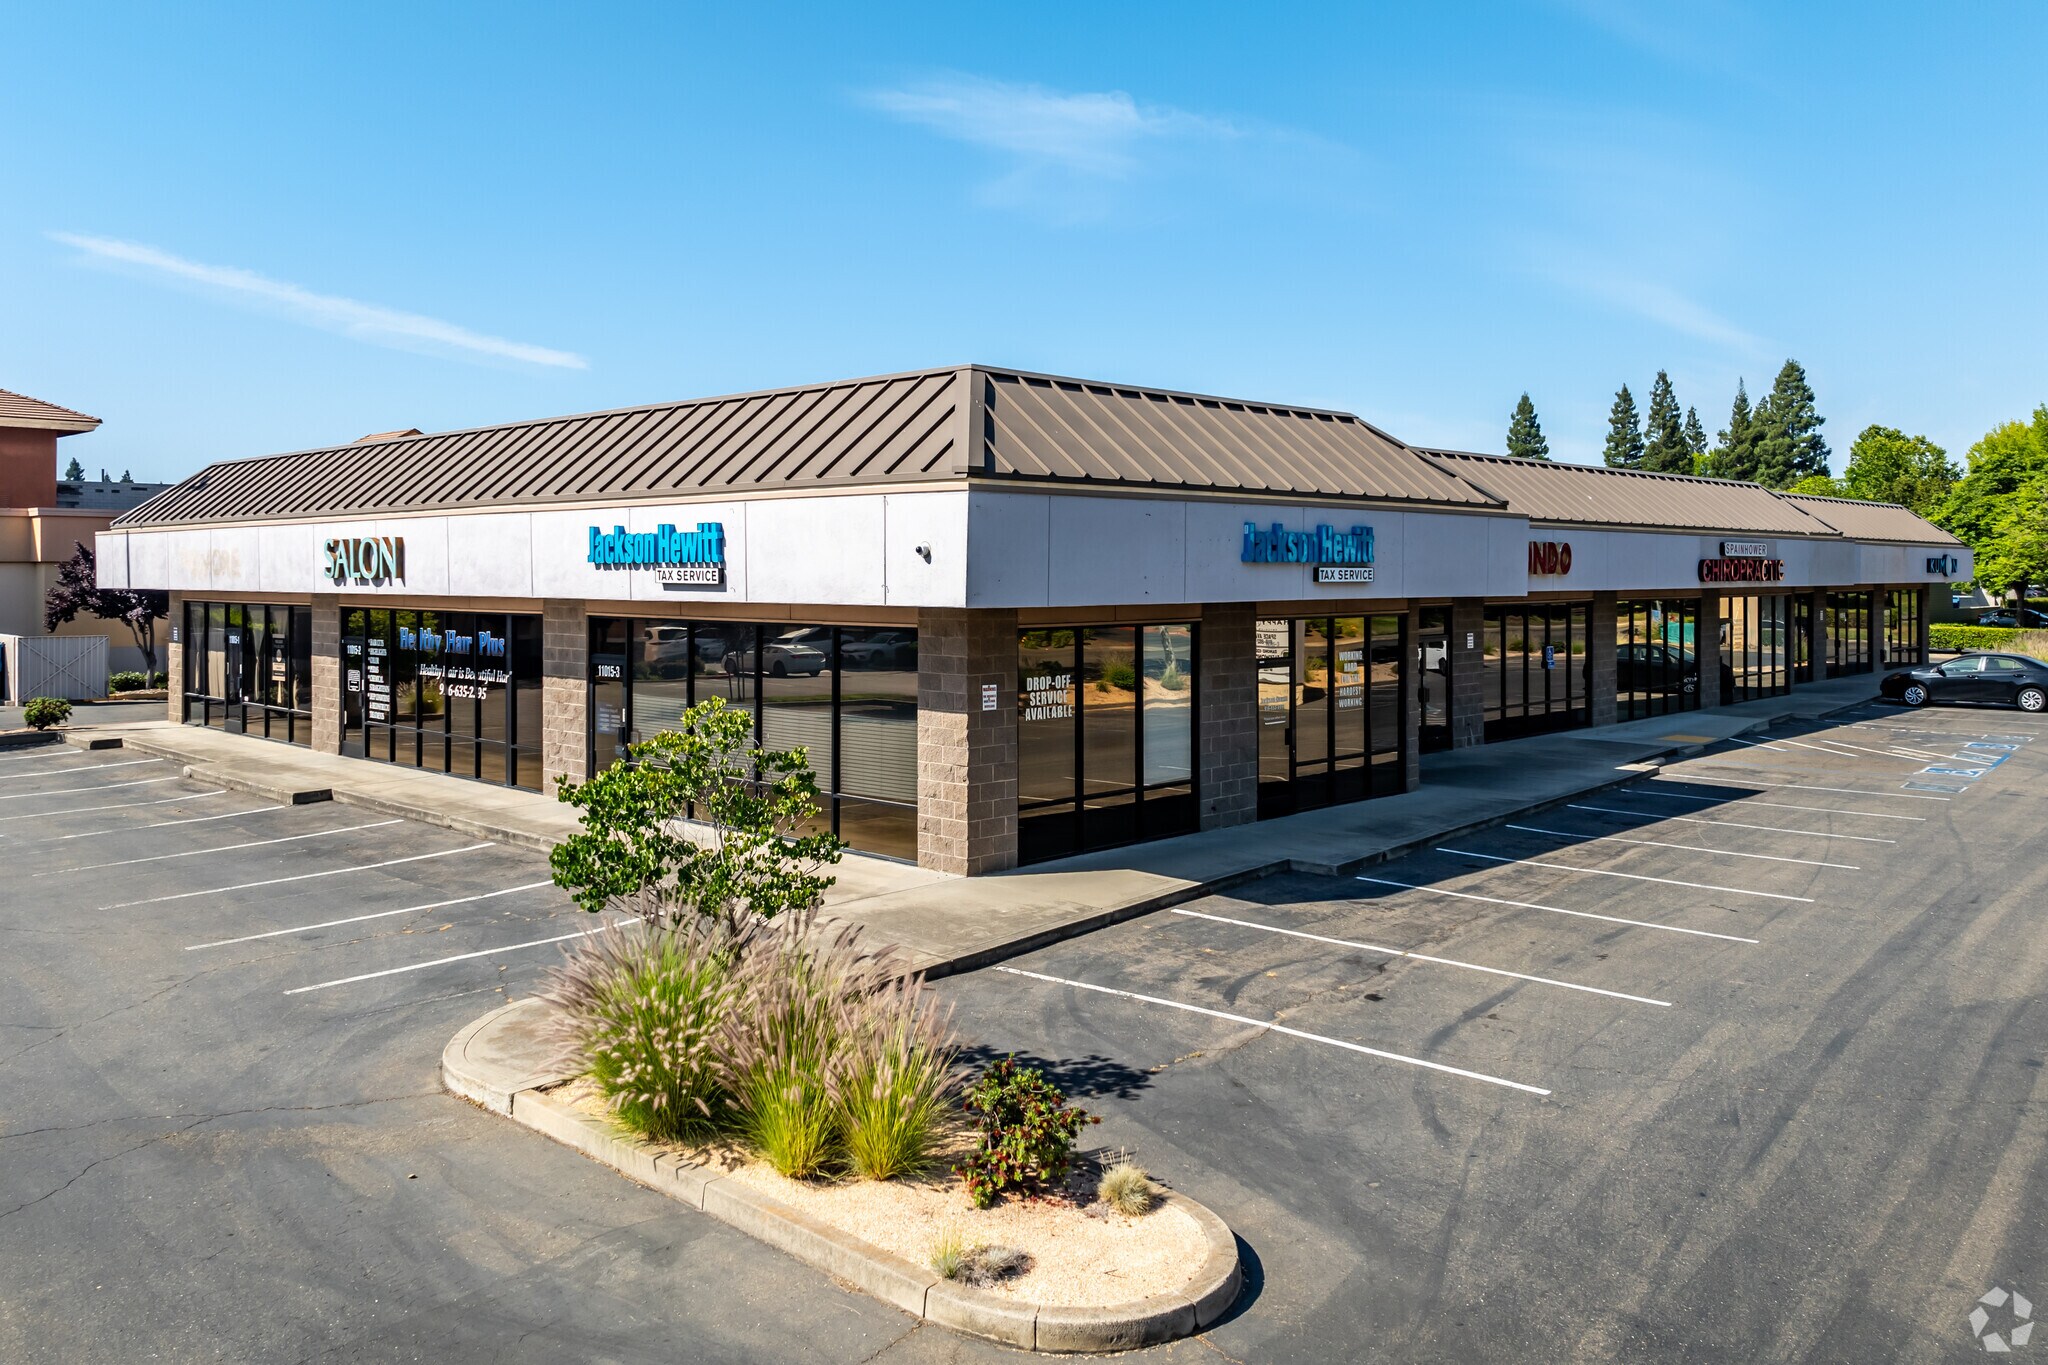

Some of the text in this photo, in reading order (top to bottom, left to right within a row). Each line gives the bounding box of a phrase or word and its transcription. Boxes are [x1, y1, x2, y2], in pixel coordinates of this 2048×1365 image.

[587, 522, 723, 563] Jackson Hewitt
[1241, 522, 1374, 563] Jackson Hewitt
[1725, 543, 1767, 555] SPAINHOWER
[323, 536, 400, 580] SALON
[1528, 541, 1572, 575] NDO
[657, 570, 717, 582] TAX SERVICE
[1320, 569, 1373, 580] TAX SERVICE
[1702, 559, 1785, 582] CHIROPRACTIC
[400, 627, 505, 657] Helthy Hair Plus
[1338, 650, 1363, 661] WORKING
[458, 667, 465, 679] is
[598, 664, 620, 678] 11015-3
[439, 682, 487, 700] 96-635-295
[1026, 674, 1071, 692] DROP-OFF
[1339, 686, 1361, 697] HARDEST
[1029, 690, 1068, 707] SERVICE
[1338, 697, 1363, 708] WORKING
[1025, 704, 1073, 722] AVAILABLE
